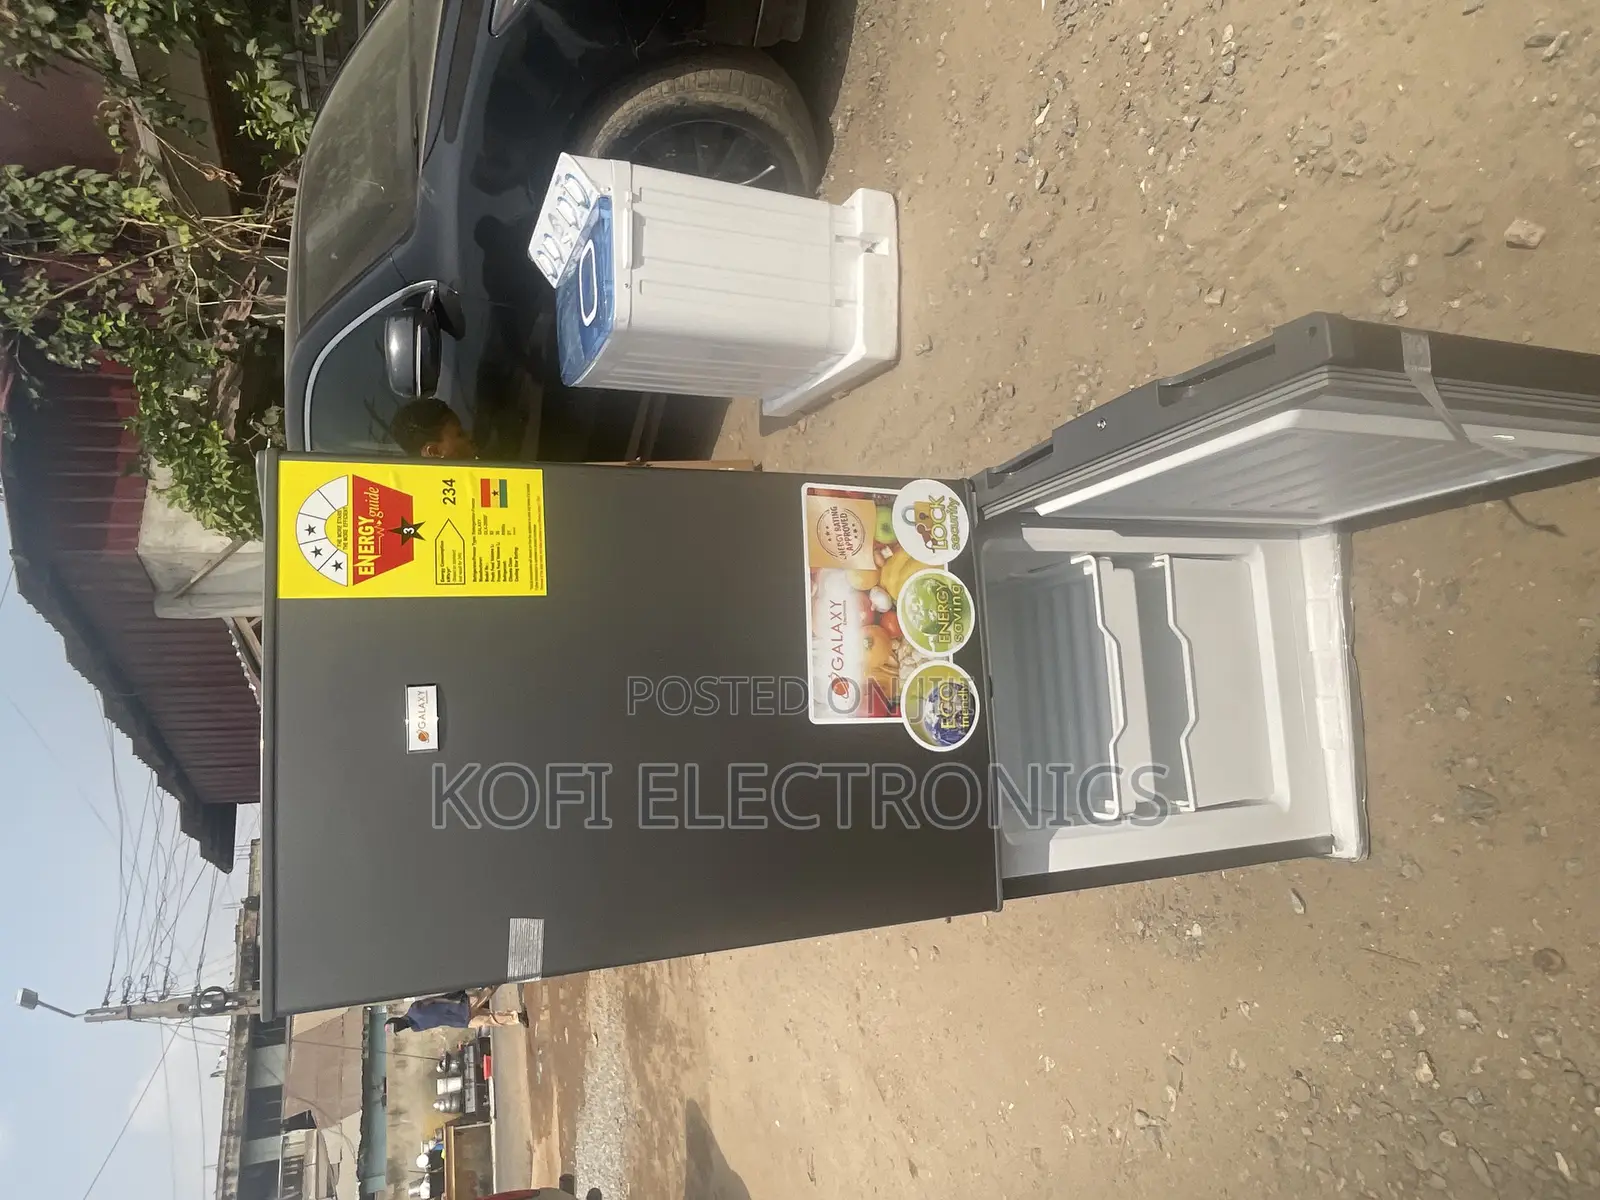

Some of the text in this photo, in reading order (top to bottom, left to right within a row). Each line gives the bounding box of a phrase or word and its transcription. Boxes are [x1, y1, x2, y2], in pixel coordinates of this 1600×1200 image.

[441, 478, 456, 506] 234
[353, 486, 384, 575] ENERGY guide
[403, 527, 415, 535] 3
[830, 506, 847, 559] ENERGY RATING
[840, 512, 853, 551] APPROVED
[928, 495, 948, 550] LOCK
[946, 497, 961, 551] security
[829, 599, 844, 671] GALAXY
[935, 580, 951, 643] ENERGY
[949, 583, 965, 643] saving
[417, 690, 427, 730] GALAXY
[939, 682, 956, 729] ECO
